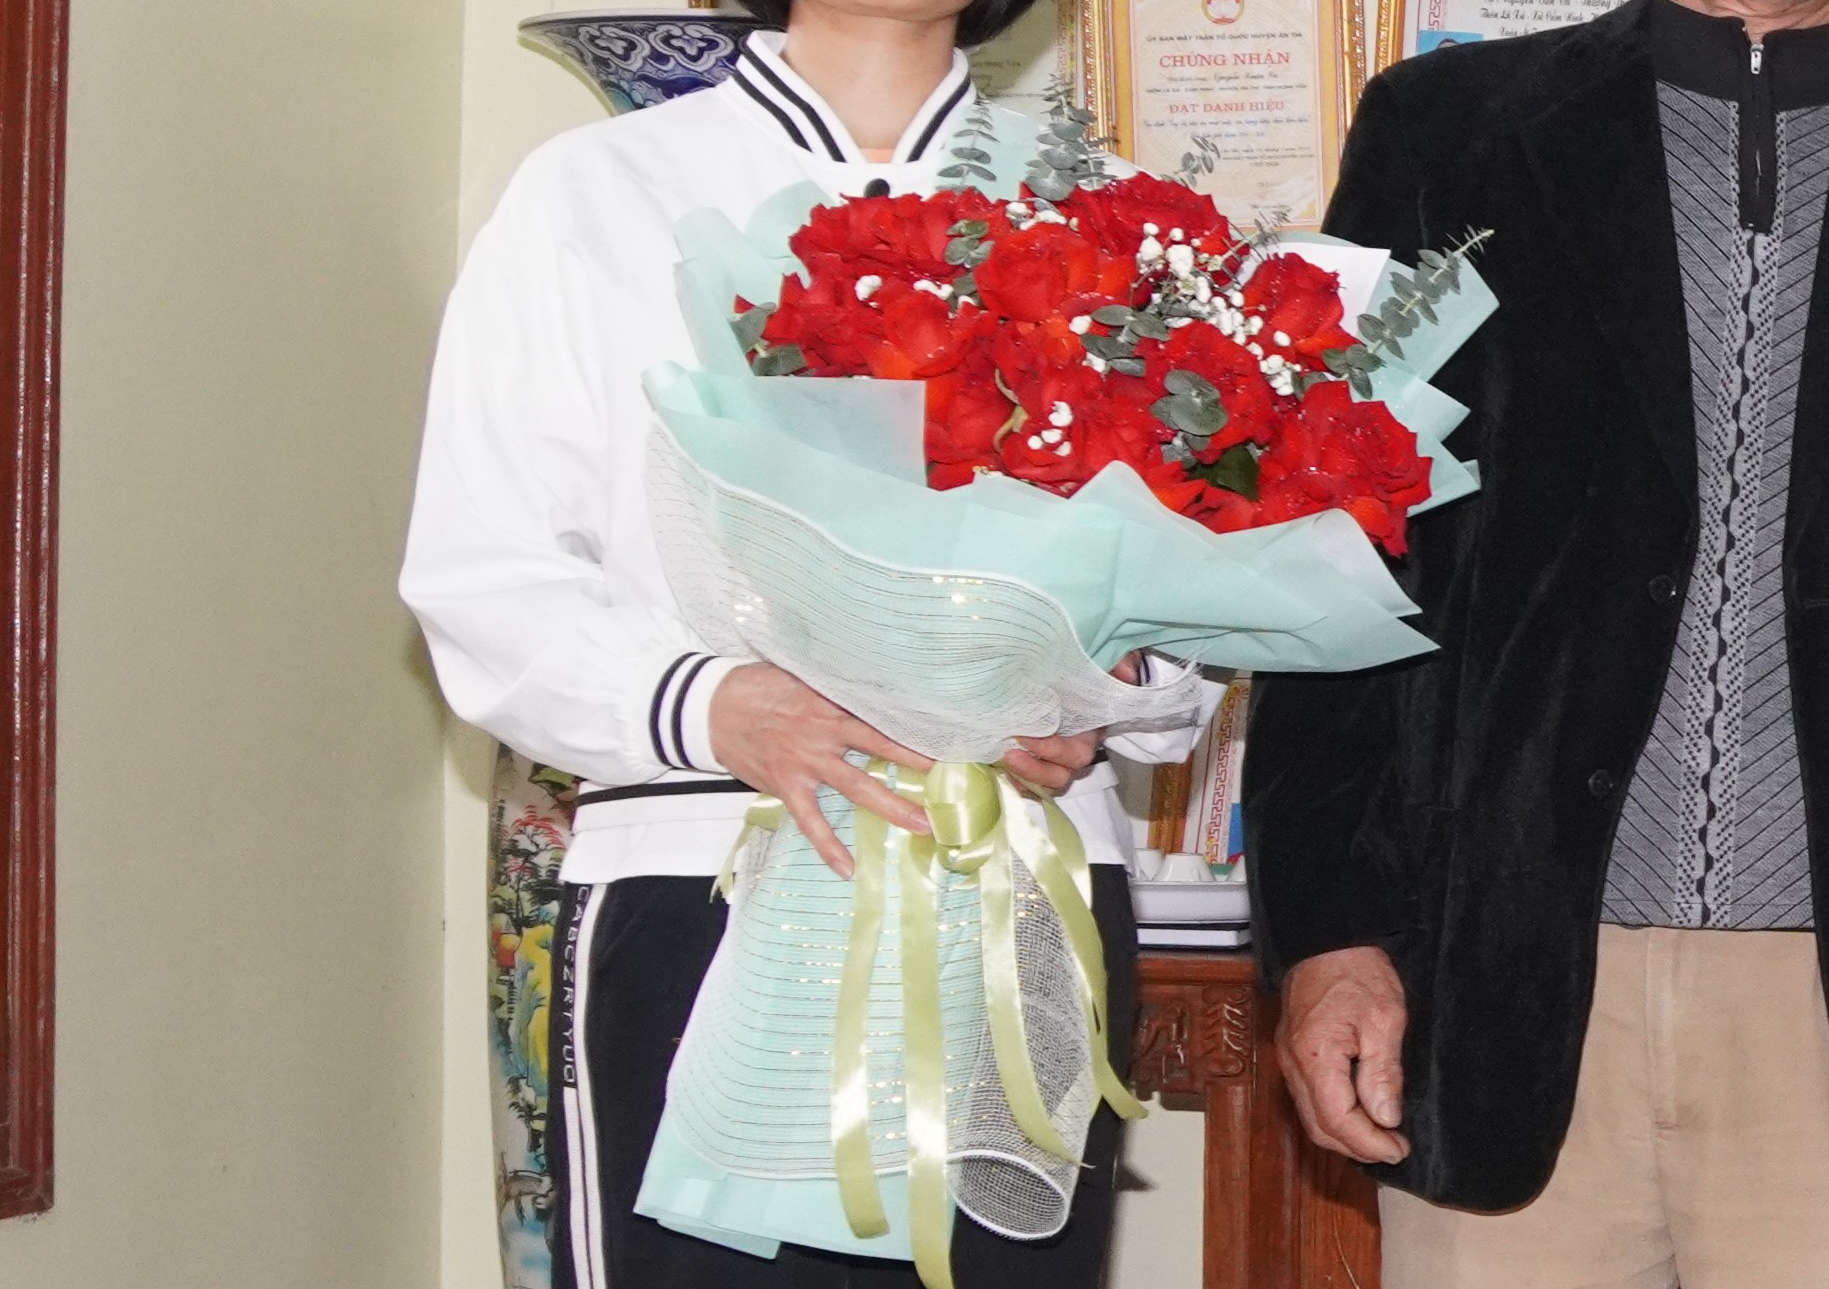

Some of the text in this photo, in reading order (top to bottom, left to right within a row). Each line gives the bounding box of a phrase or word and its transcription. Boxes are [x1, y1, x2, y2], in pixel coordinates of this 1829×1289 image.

[1159, 49, 1291, 68] CHỨNG NHẬN
[1204, 102, 1244, 113] DANH
